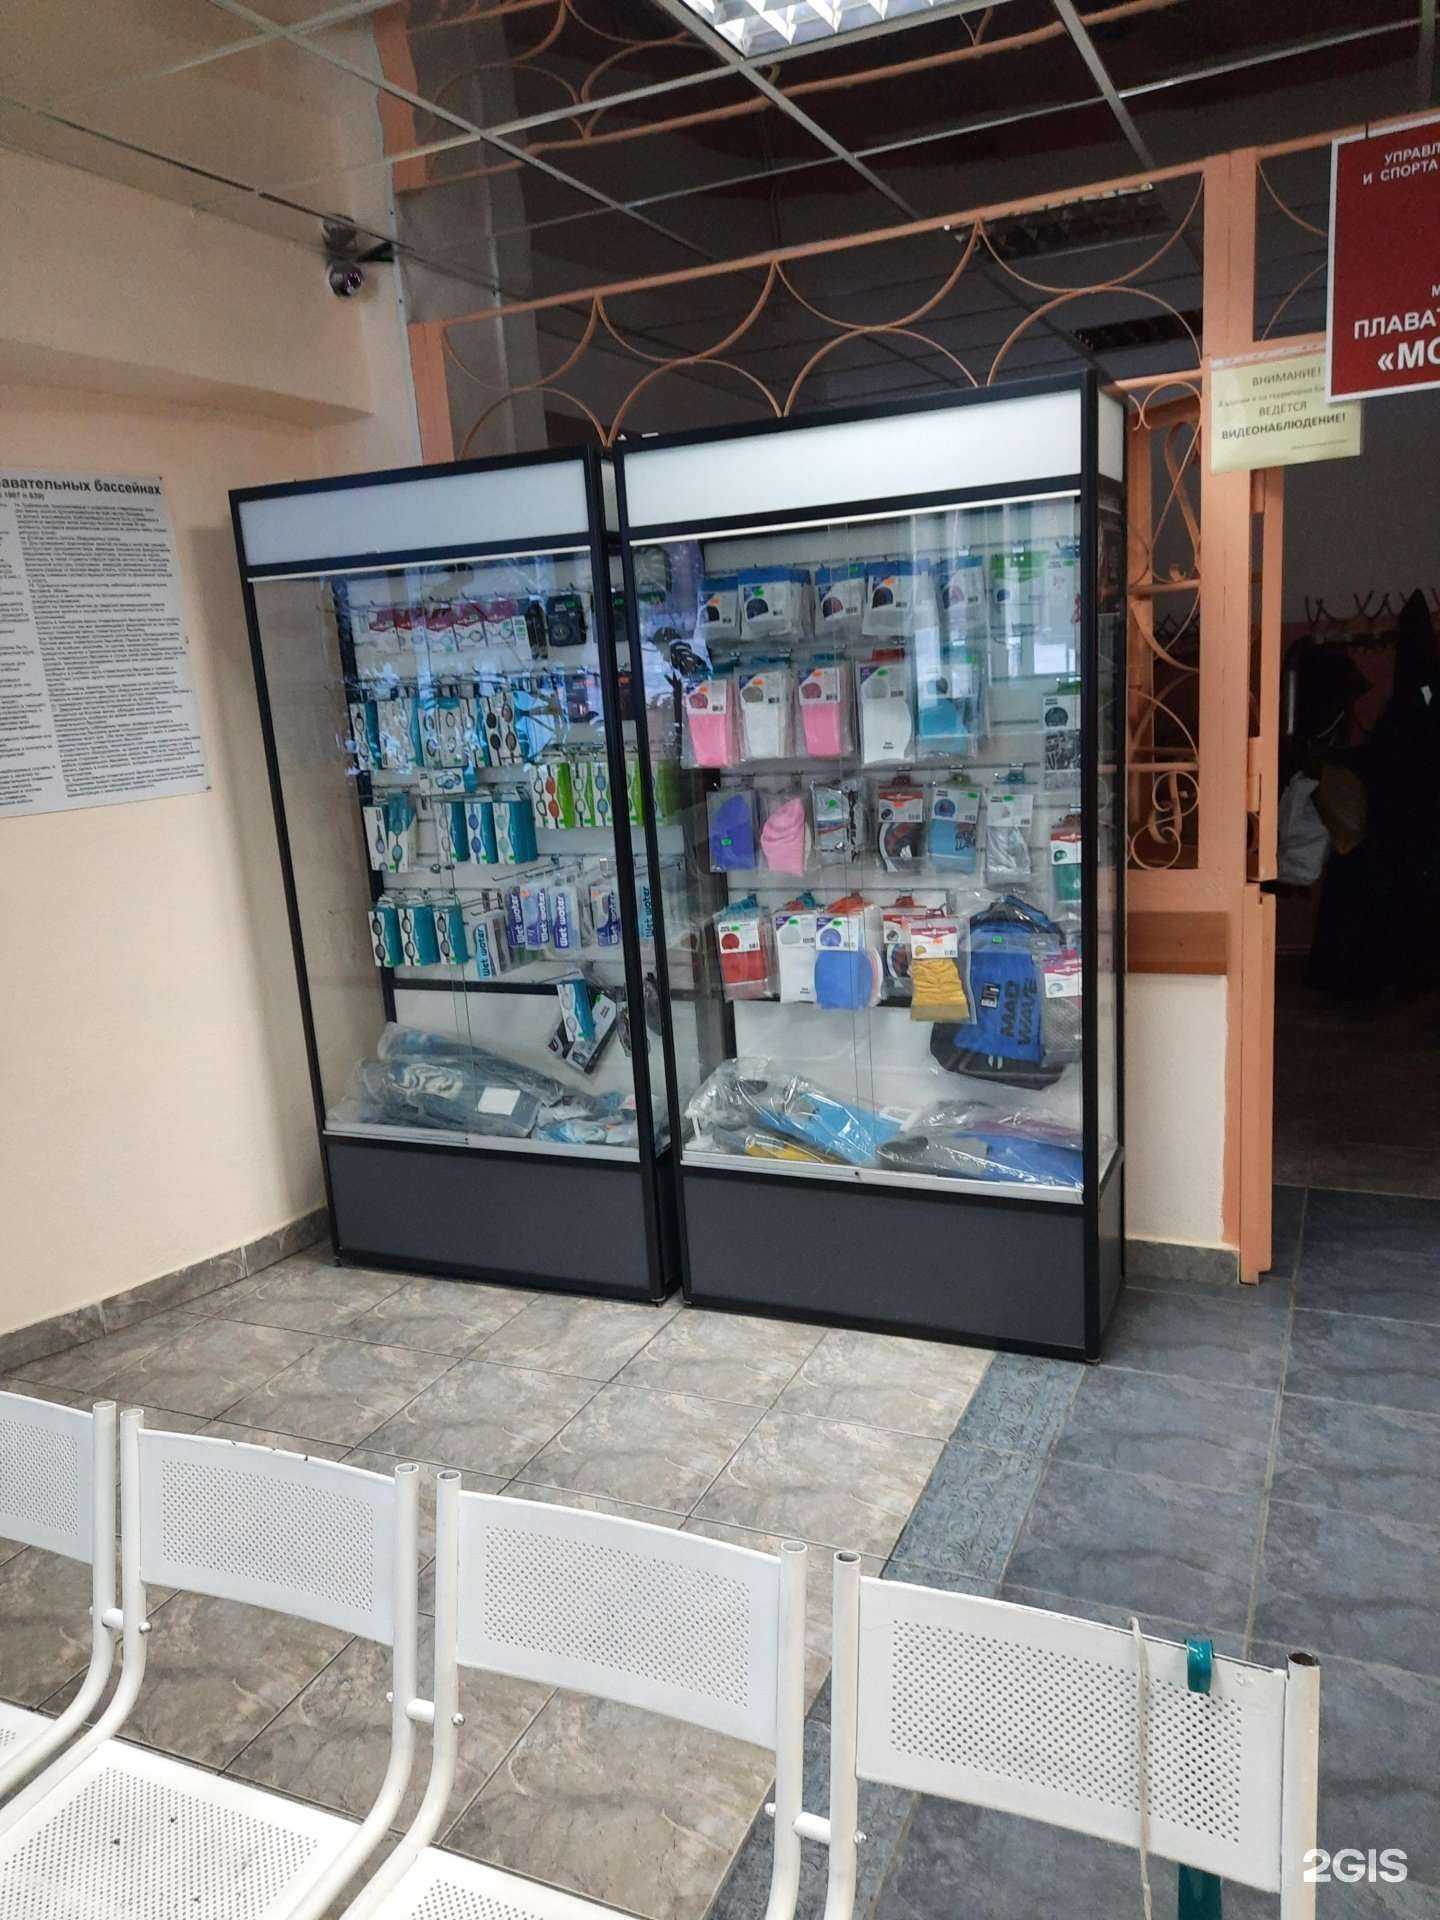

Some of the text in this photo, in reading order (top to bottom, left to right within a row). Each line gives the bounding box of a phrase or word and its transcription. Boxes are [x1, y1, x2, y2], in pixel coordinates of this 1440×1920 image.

[1363, 159, 1438, 185] И СПОРТА
[1354, 308, 1440, 340] ПЛАВА
[1252, 366, 1322, 387] ВНИМАНИЕ!
[1222, 412, 1346, 440] ВИДЕОНАБЛЮДЕНИЕ!
[0, 477, 161, 495] авательных бассейнах
